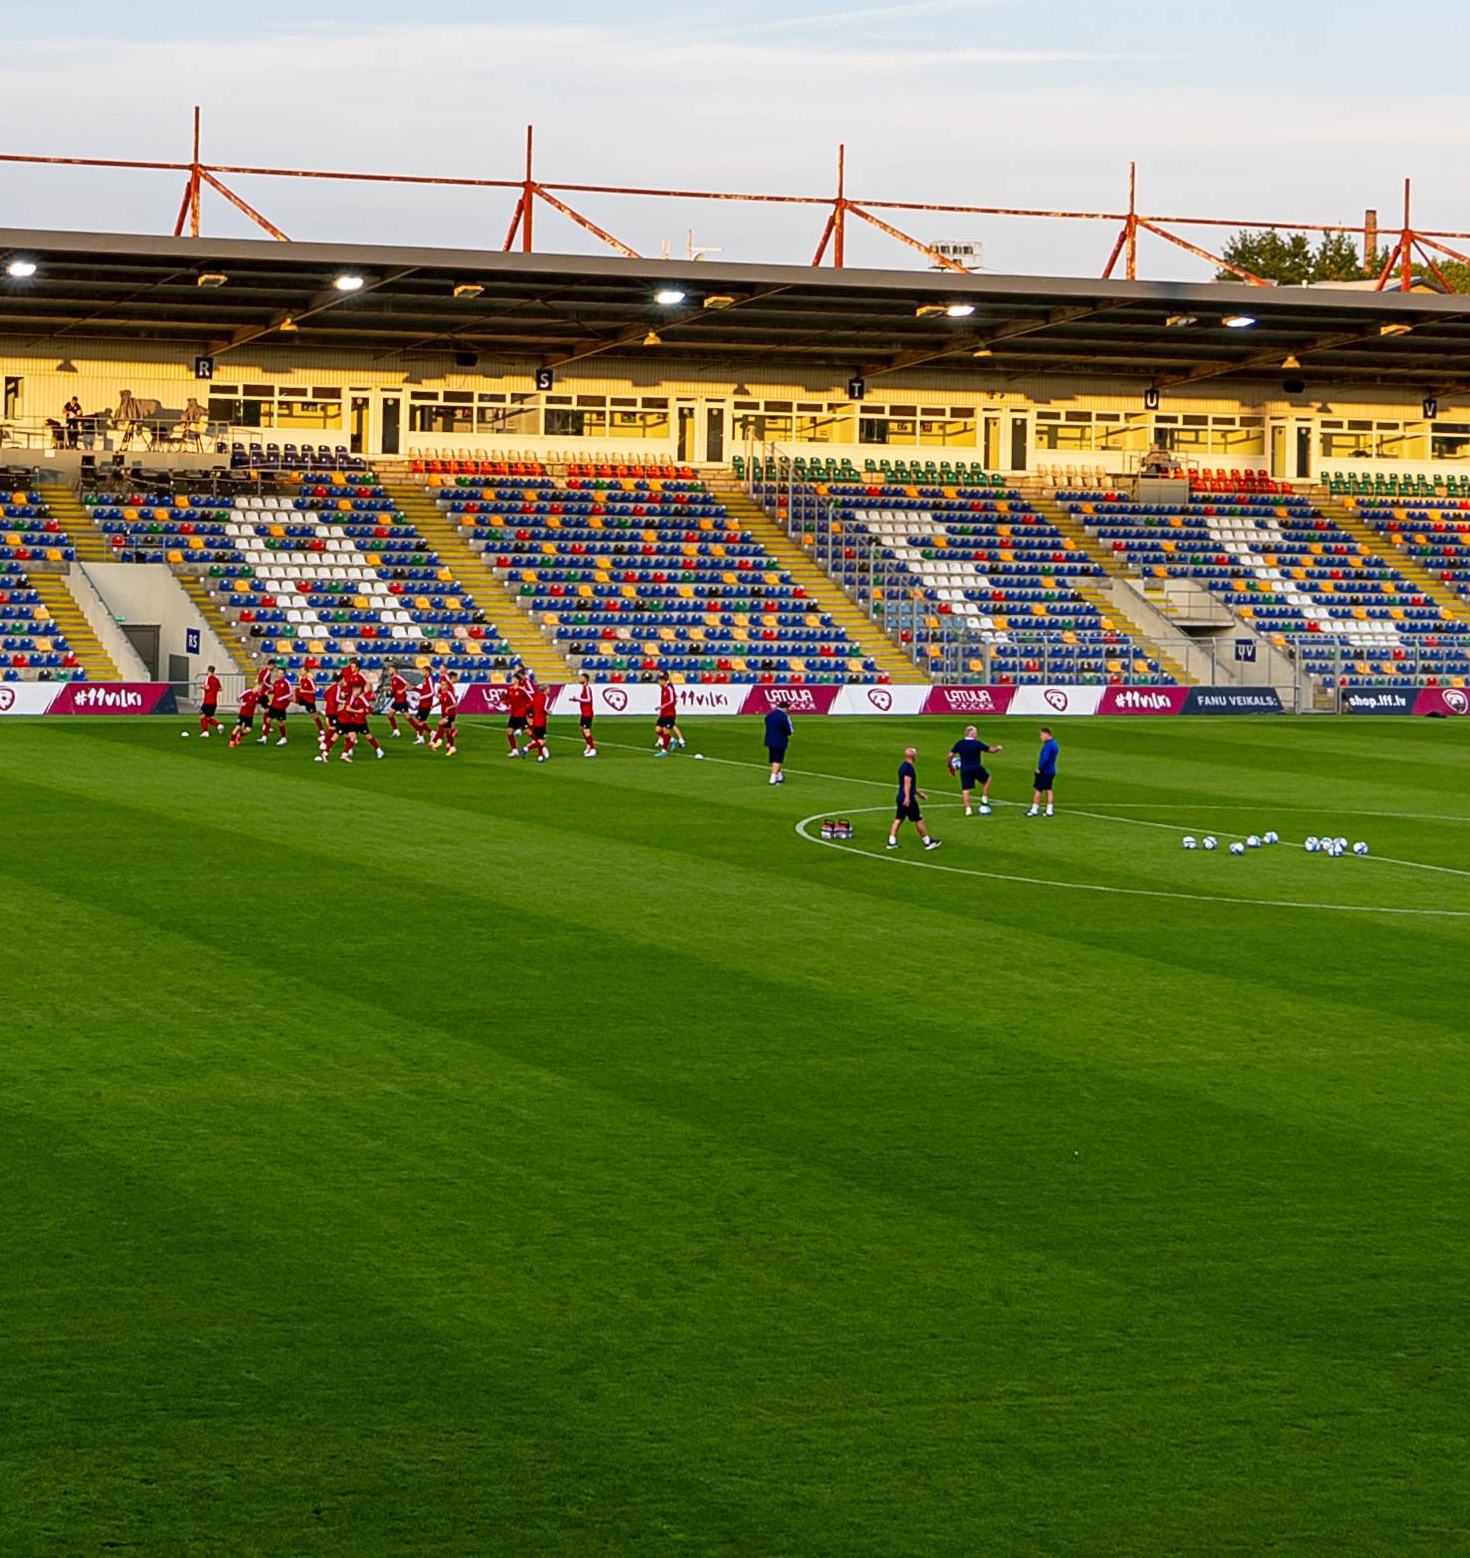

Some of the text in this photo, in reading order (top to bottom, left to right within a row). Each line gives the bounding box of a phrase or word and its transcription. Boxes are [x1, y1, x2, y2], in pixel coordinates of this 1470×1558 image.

[199, 361, 209, 377] R
[539, 373, 549, 388] S
[852, 382, 861, 397] T
[1146, 392, 1157, 407] U
[1425, 402, 1435, 416] V
[189, 633, 198, 649] RS
[1197, 696, 1279, 706] FANU VEIKALS:
[1349, 694, 1406, 709] shop.lff.lv
